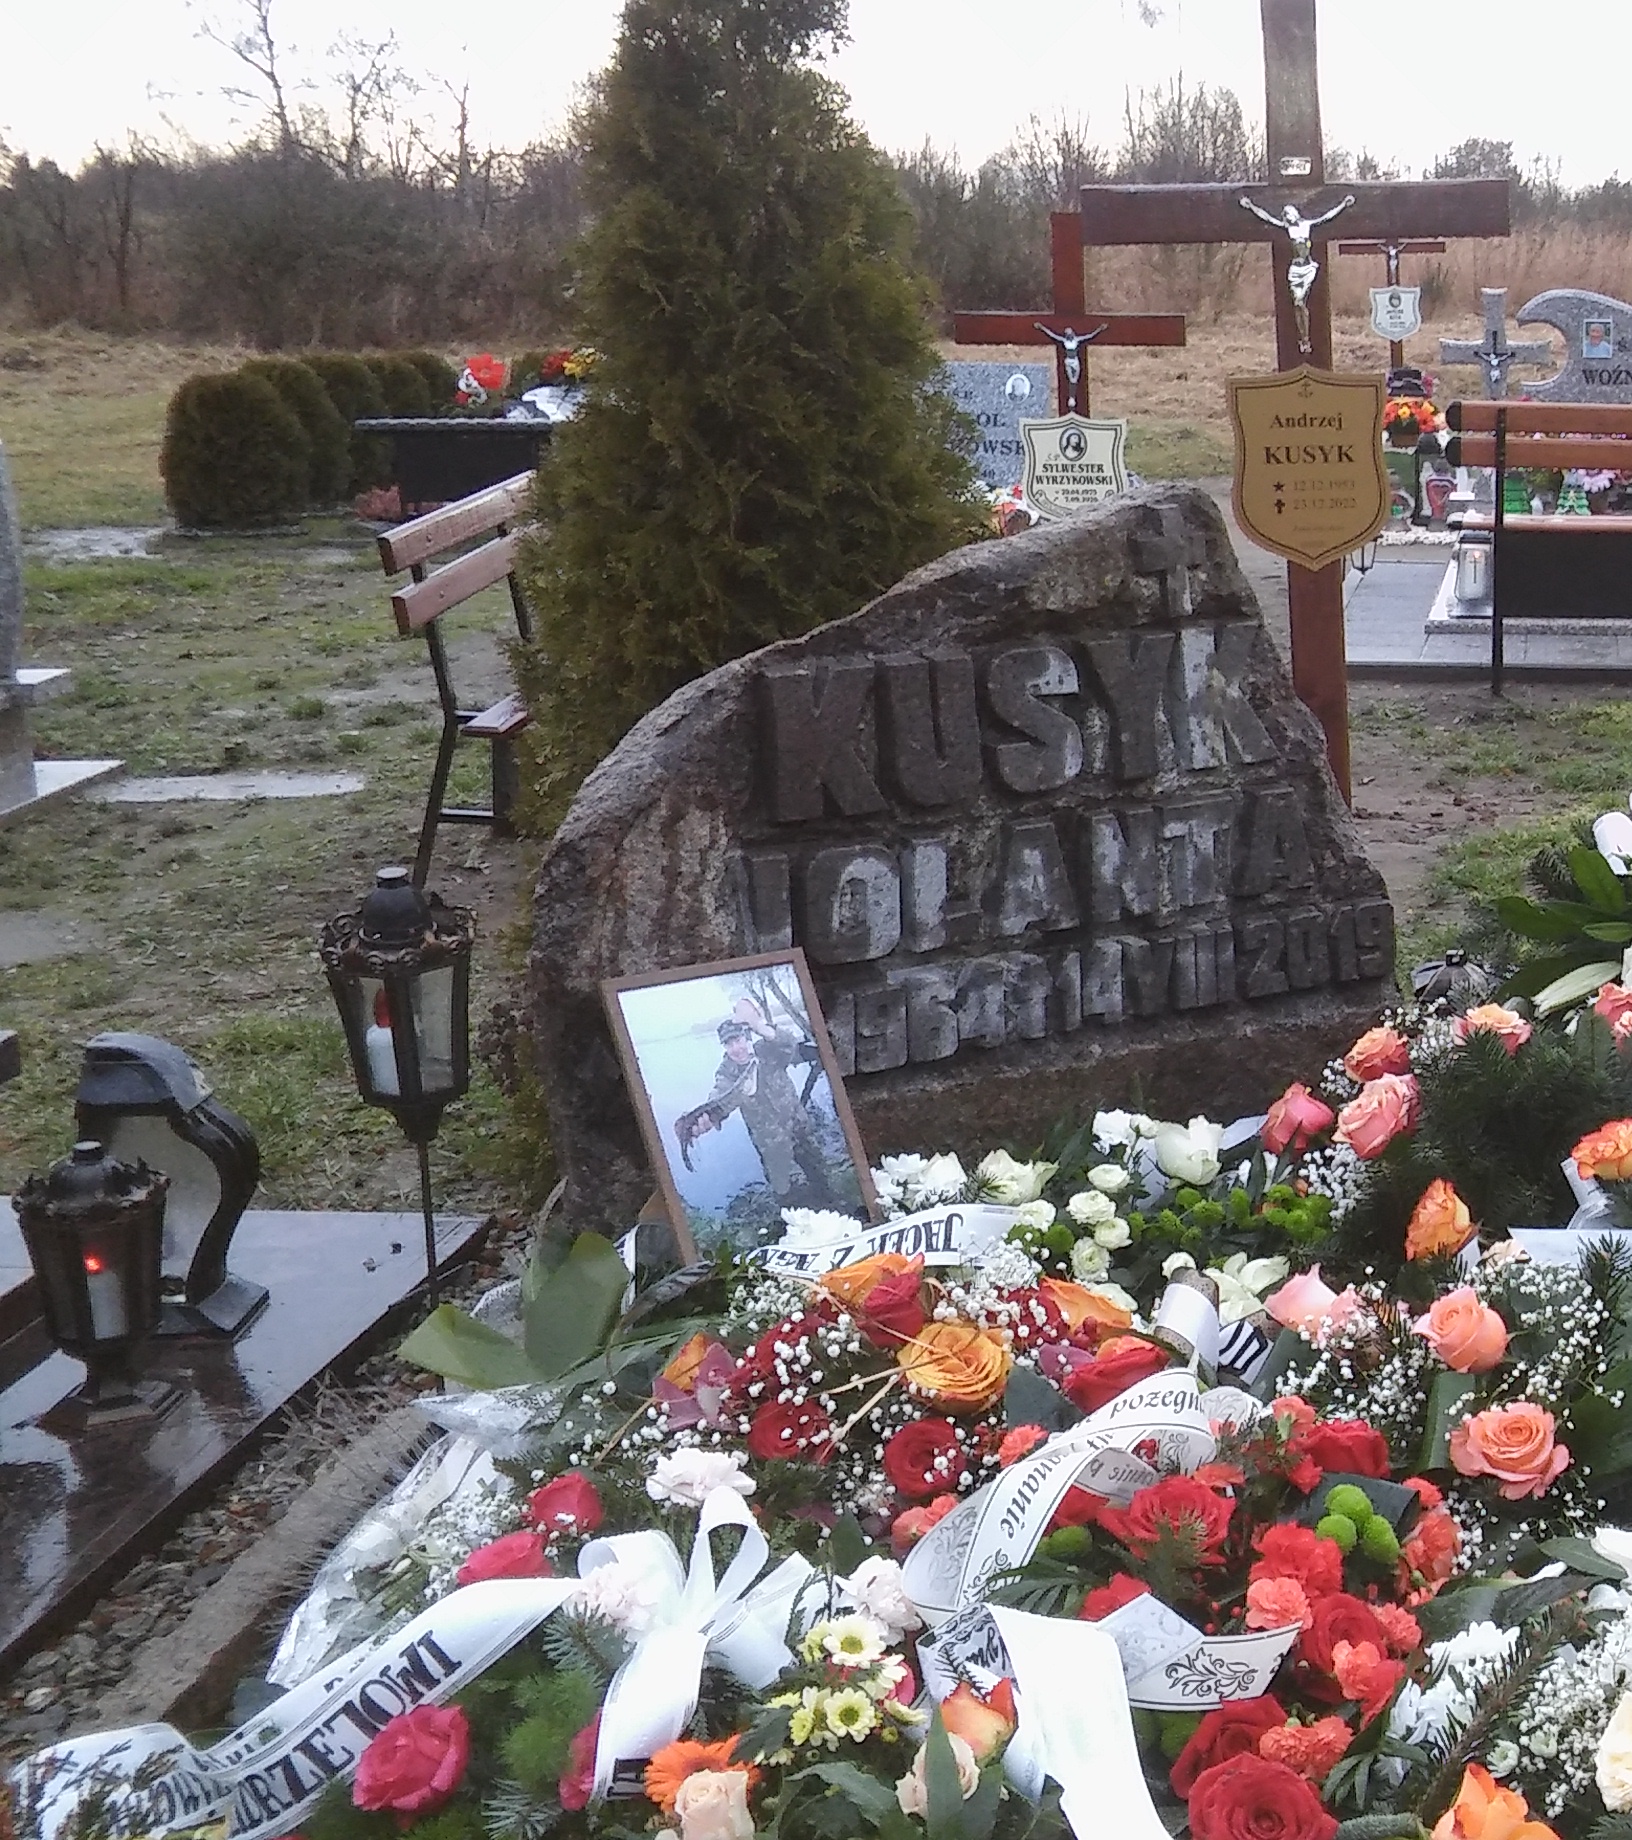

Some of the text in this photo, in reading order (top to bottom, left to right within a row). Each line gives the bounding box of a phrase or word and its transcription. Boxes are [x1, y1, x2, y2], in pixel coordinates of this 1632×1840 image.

[1270, 412, 1343, 430] Andrzej
[1264, 444, 1356, 465] KUSYK
[1042, 463, 1105, 474] SYLWESTER
[1035, 475, 1113, 486] WYRZYKOWSKI
[764, 622, 1281, 824] KUSYK
[740, 783, 1316, 965] JOLANTA
[1246, 898, 1396, 998] 2019
